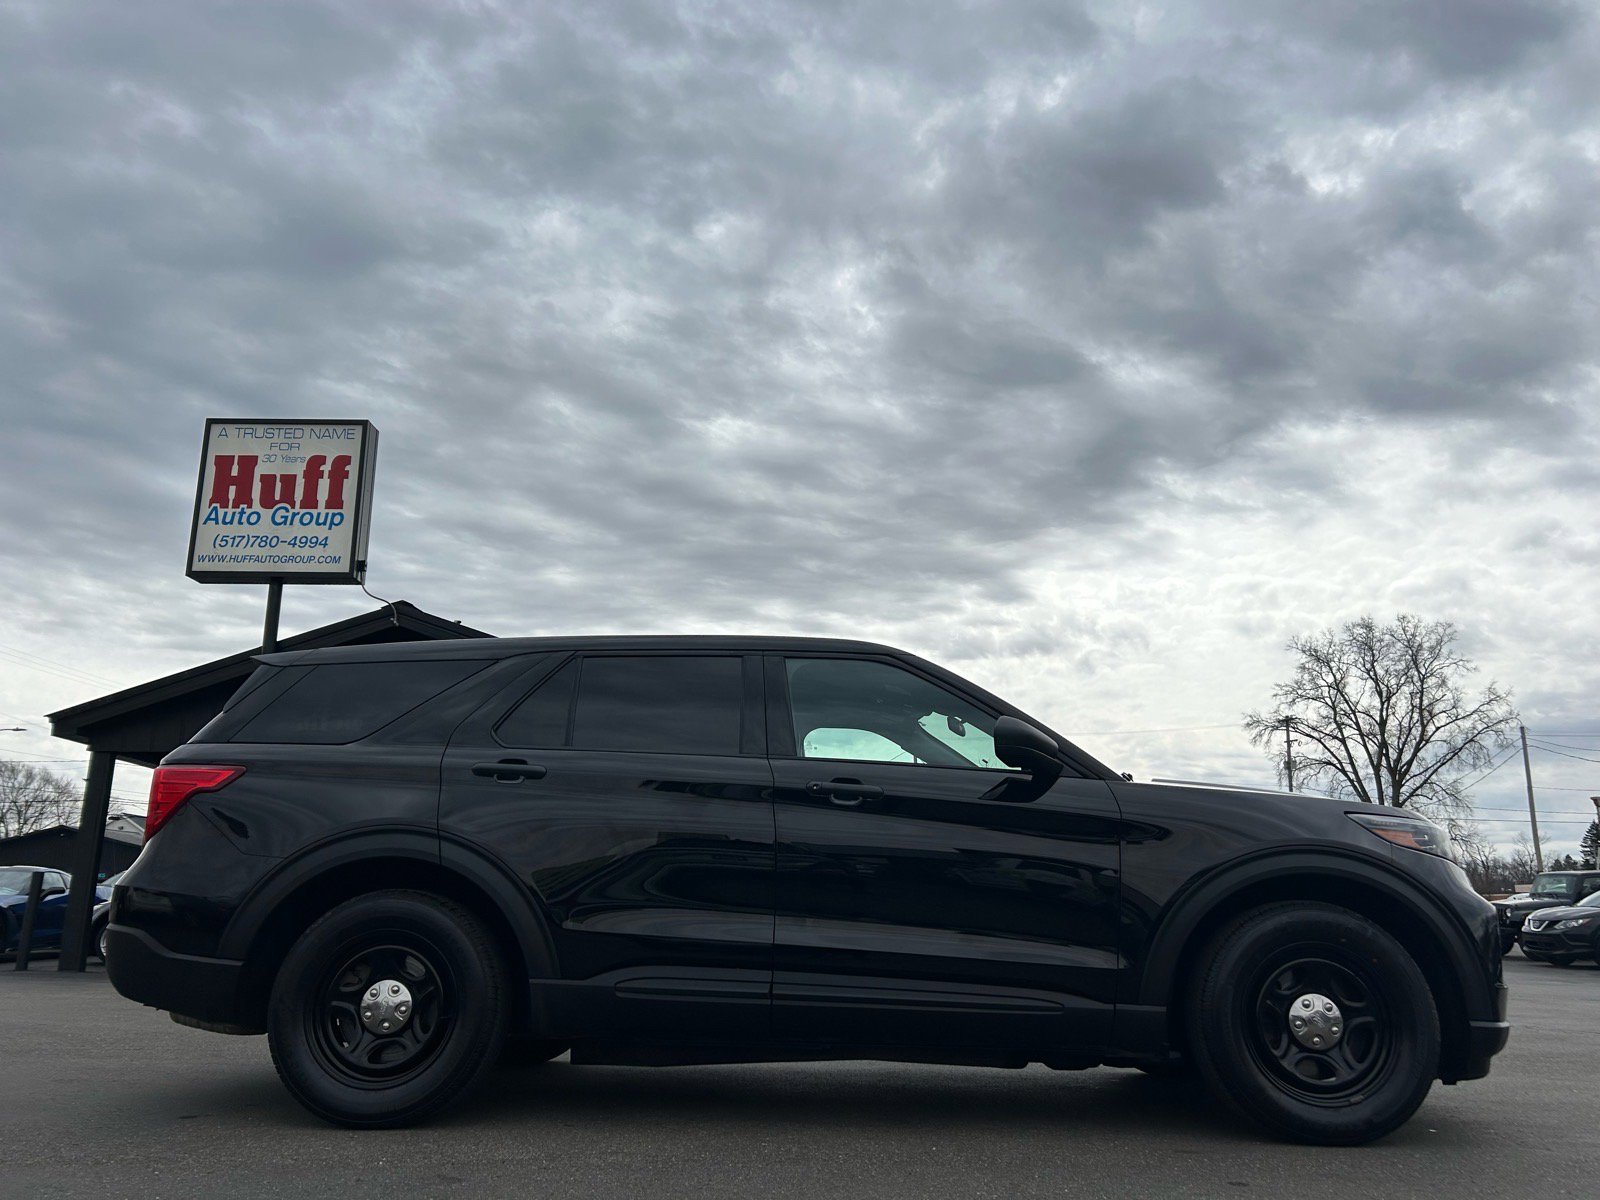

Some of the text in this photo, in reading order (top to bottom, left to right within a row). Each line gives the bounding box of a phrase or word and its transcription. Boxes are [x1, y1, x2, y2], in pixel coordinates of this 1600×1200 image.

[217, 427, 356, 440] A TRUSTED NAME
[269, 442, 300, 451] FOR
[261, 454, 306, 464] 30 Years
[208, 454, 352, 510] Huff
[202, 505, 344, 530] Auto Group
[212, 534, 329, 549] (517)780-4994
[197, 554, 341, 564] WWW.HUFFAUTOGROUP.COM
